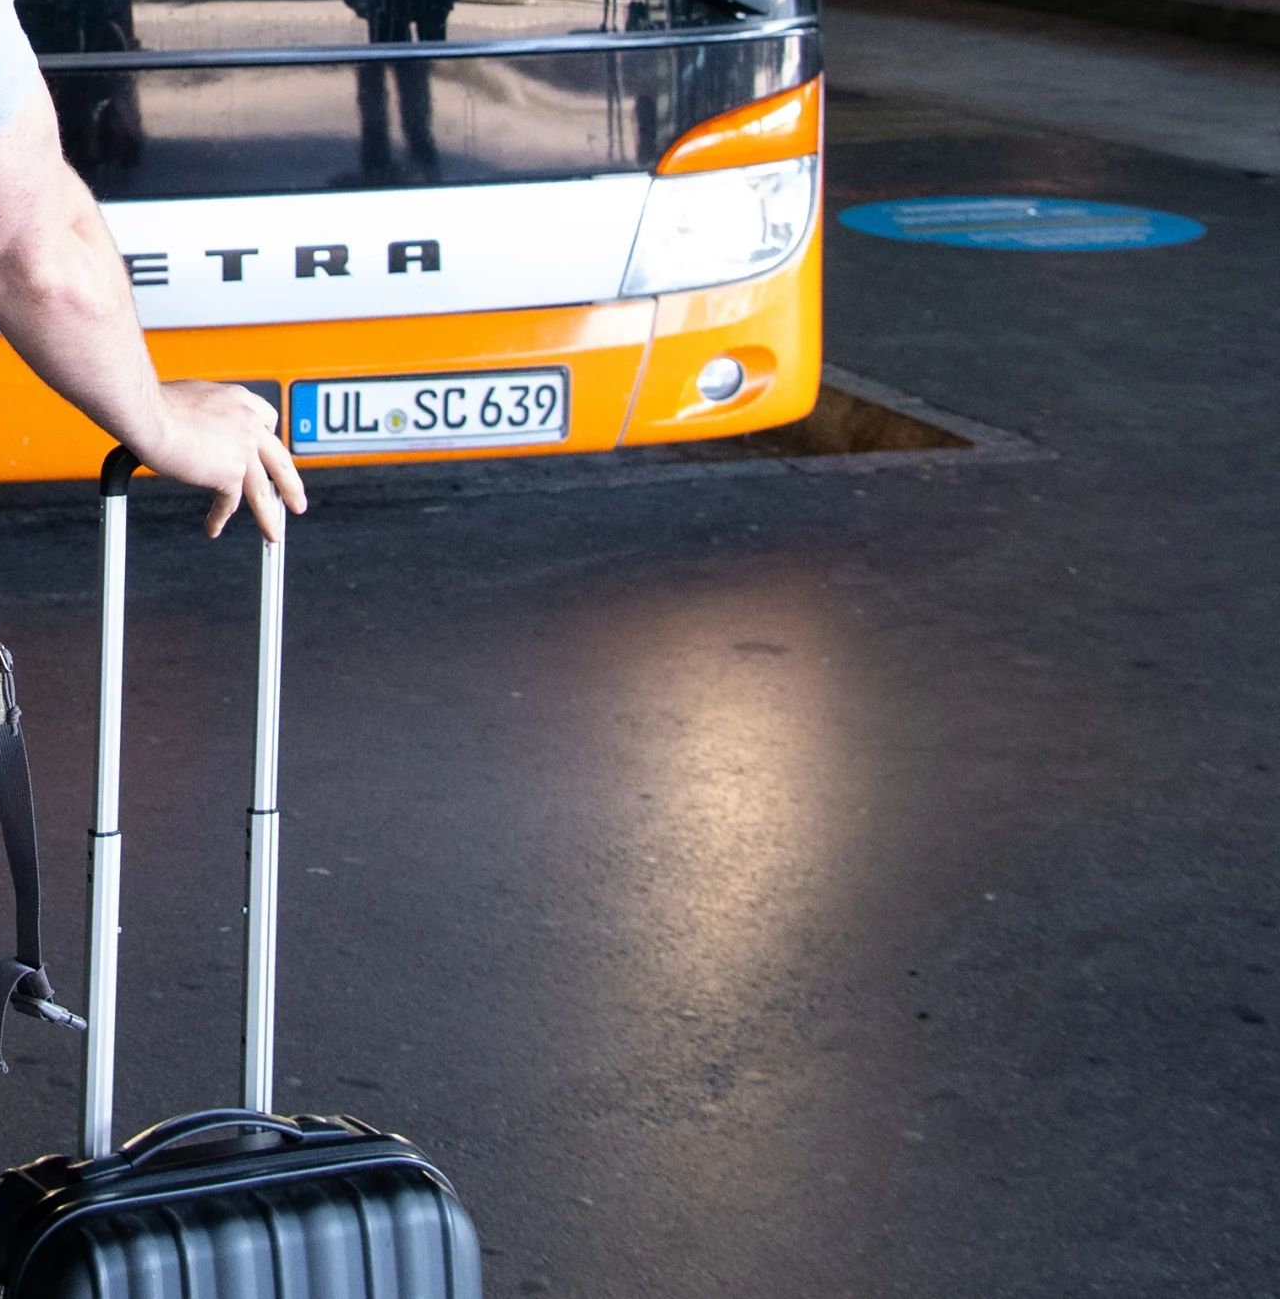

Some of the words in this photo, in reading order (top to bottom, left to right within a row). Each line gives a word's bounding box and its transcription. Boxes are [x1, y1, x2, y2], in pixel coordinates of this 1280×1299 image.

[324, 390, 379, 434] UL
[412, 387, 468, 431] SC
[479, 384, 558, 429] 639
